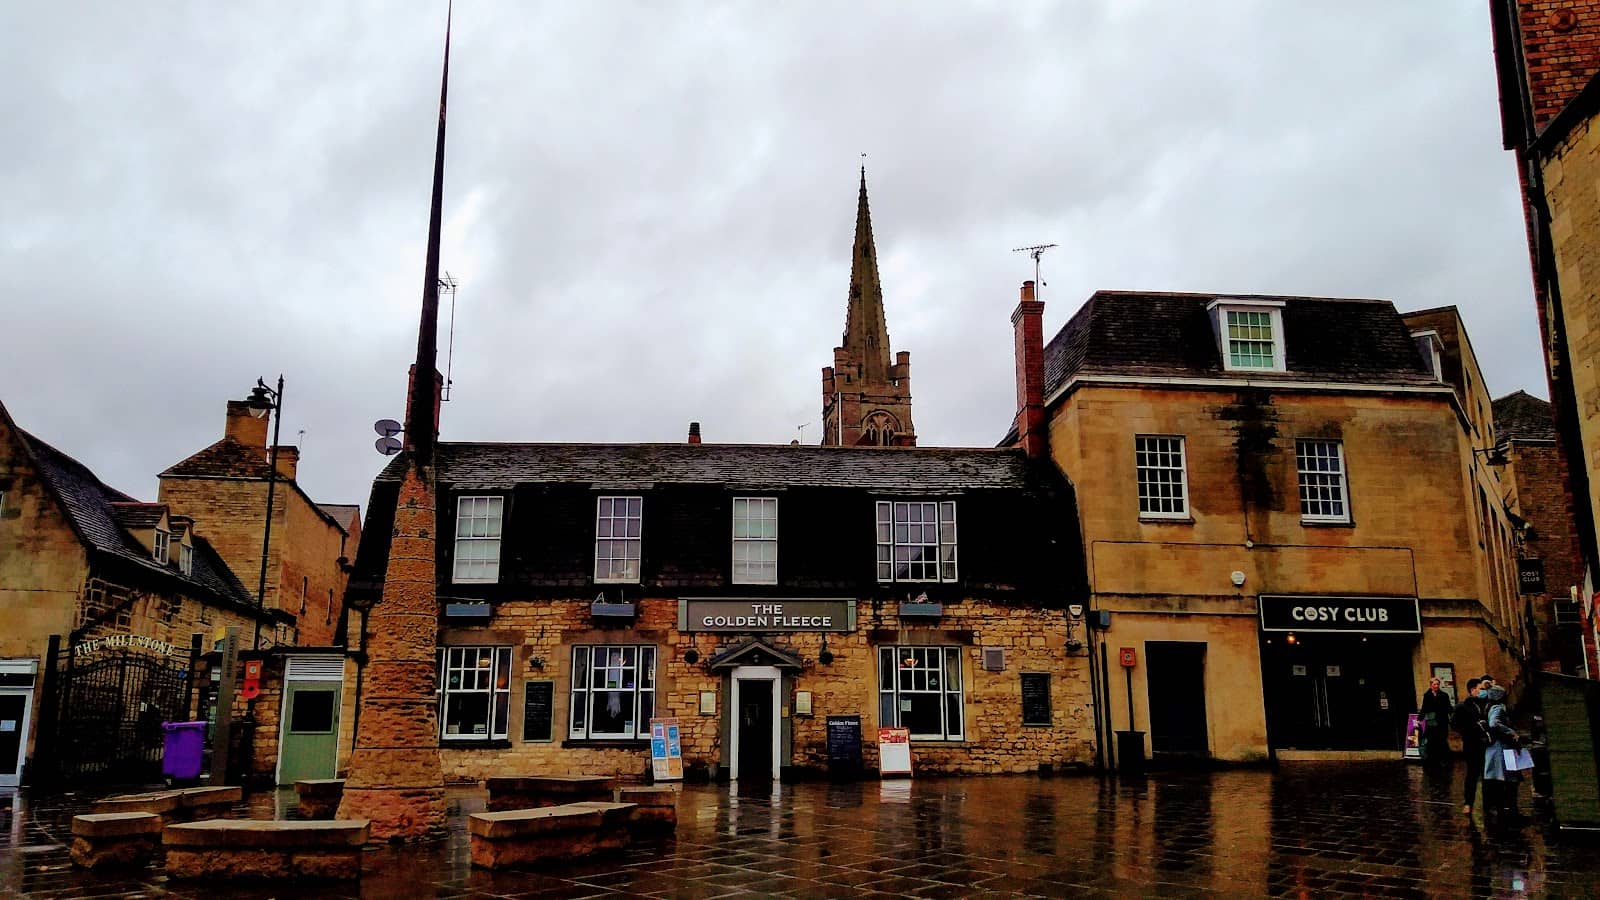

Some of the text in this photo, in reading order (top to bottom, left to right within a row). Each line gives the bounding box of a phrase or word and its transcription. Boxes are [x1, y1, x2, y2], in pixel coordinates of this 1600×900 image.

[752, 604, 782, 615] THE
[1292, 606, 1388, 622] COSY CLUB
[702, 616, 832, 627] GOLDEN FLEECE
[75, 634, 175, 657] THE MILLSTONE
